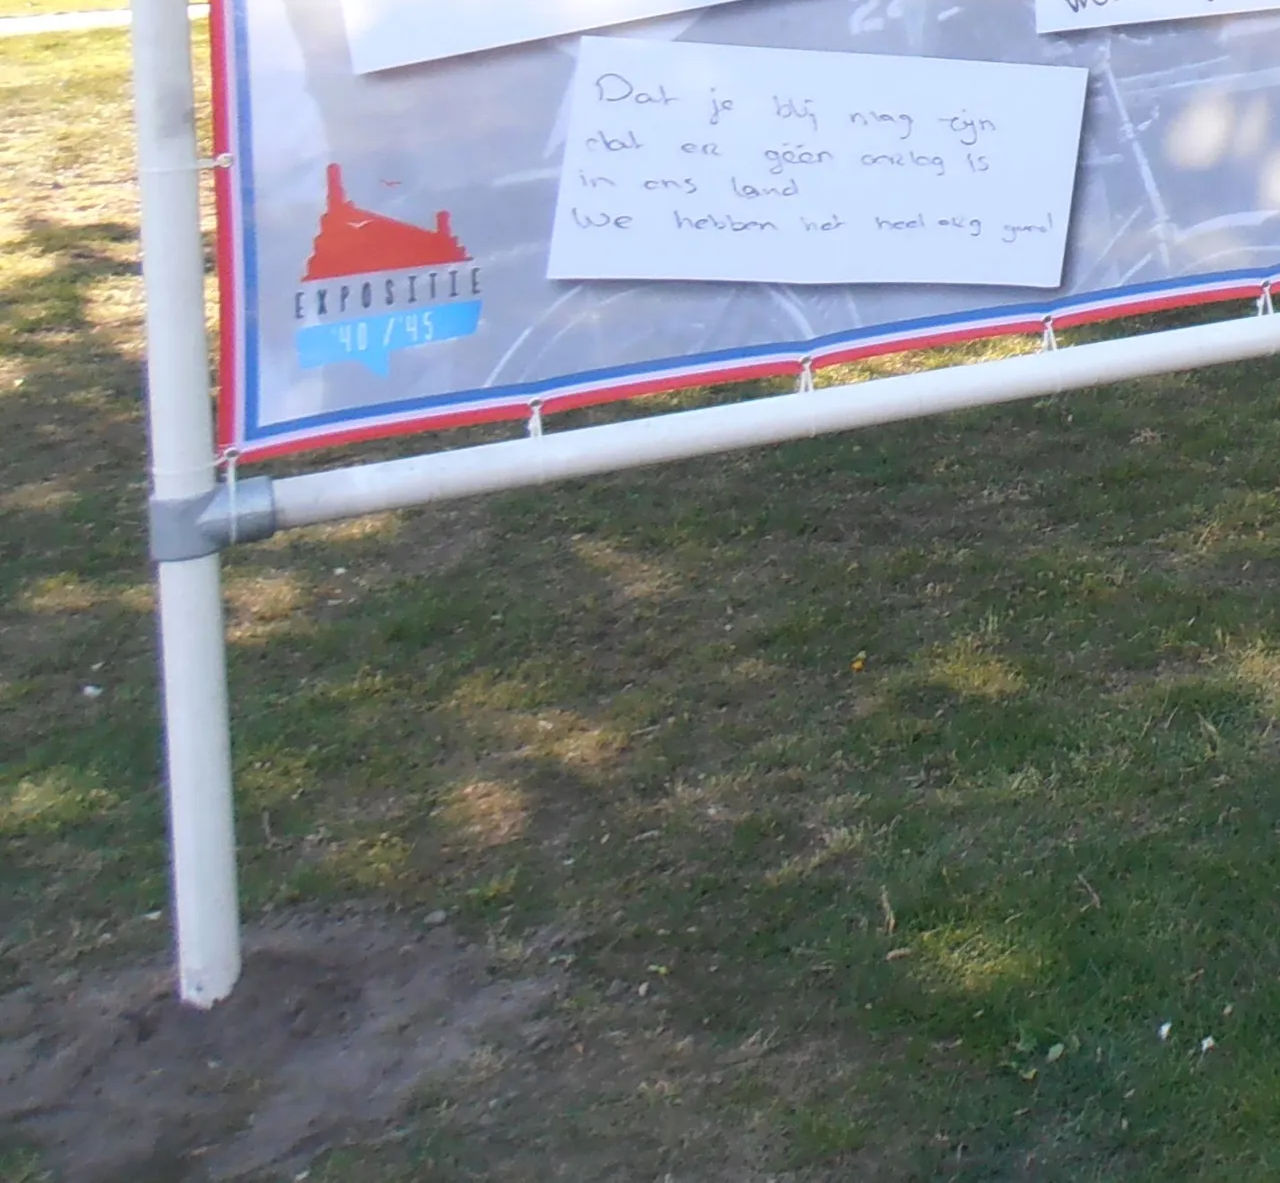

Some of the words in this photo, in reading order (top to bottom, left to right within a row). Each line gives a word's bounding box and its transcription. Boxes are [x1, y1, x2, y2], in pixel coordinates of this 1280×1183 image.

[594, 72, 681, 105] Dat
[708, 85, 735, 126] je
[729, 175, 800, 200] land
[570, 205, 635, 230] We
[672, 209, 779, 232] hebben
[294, 267, 482, 319] EXPOSITIE
